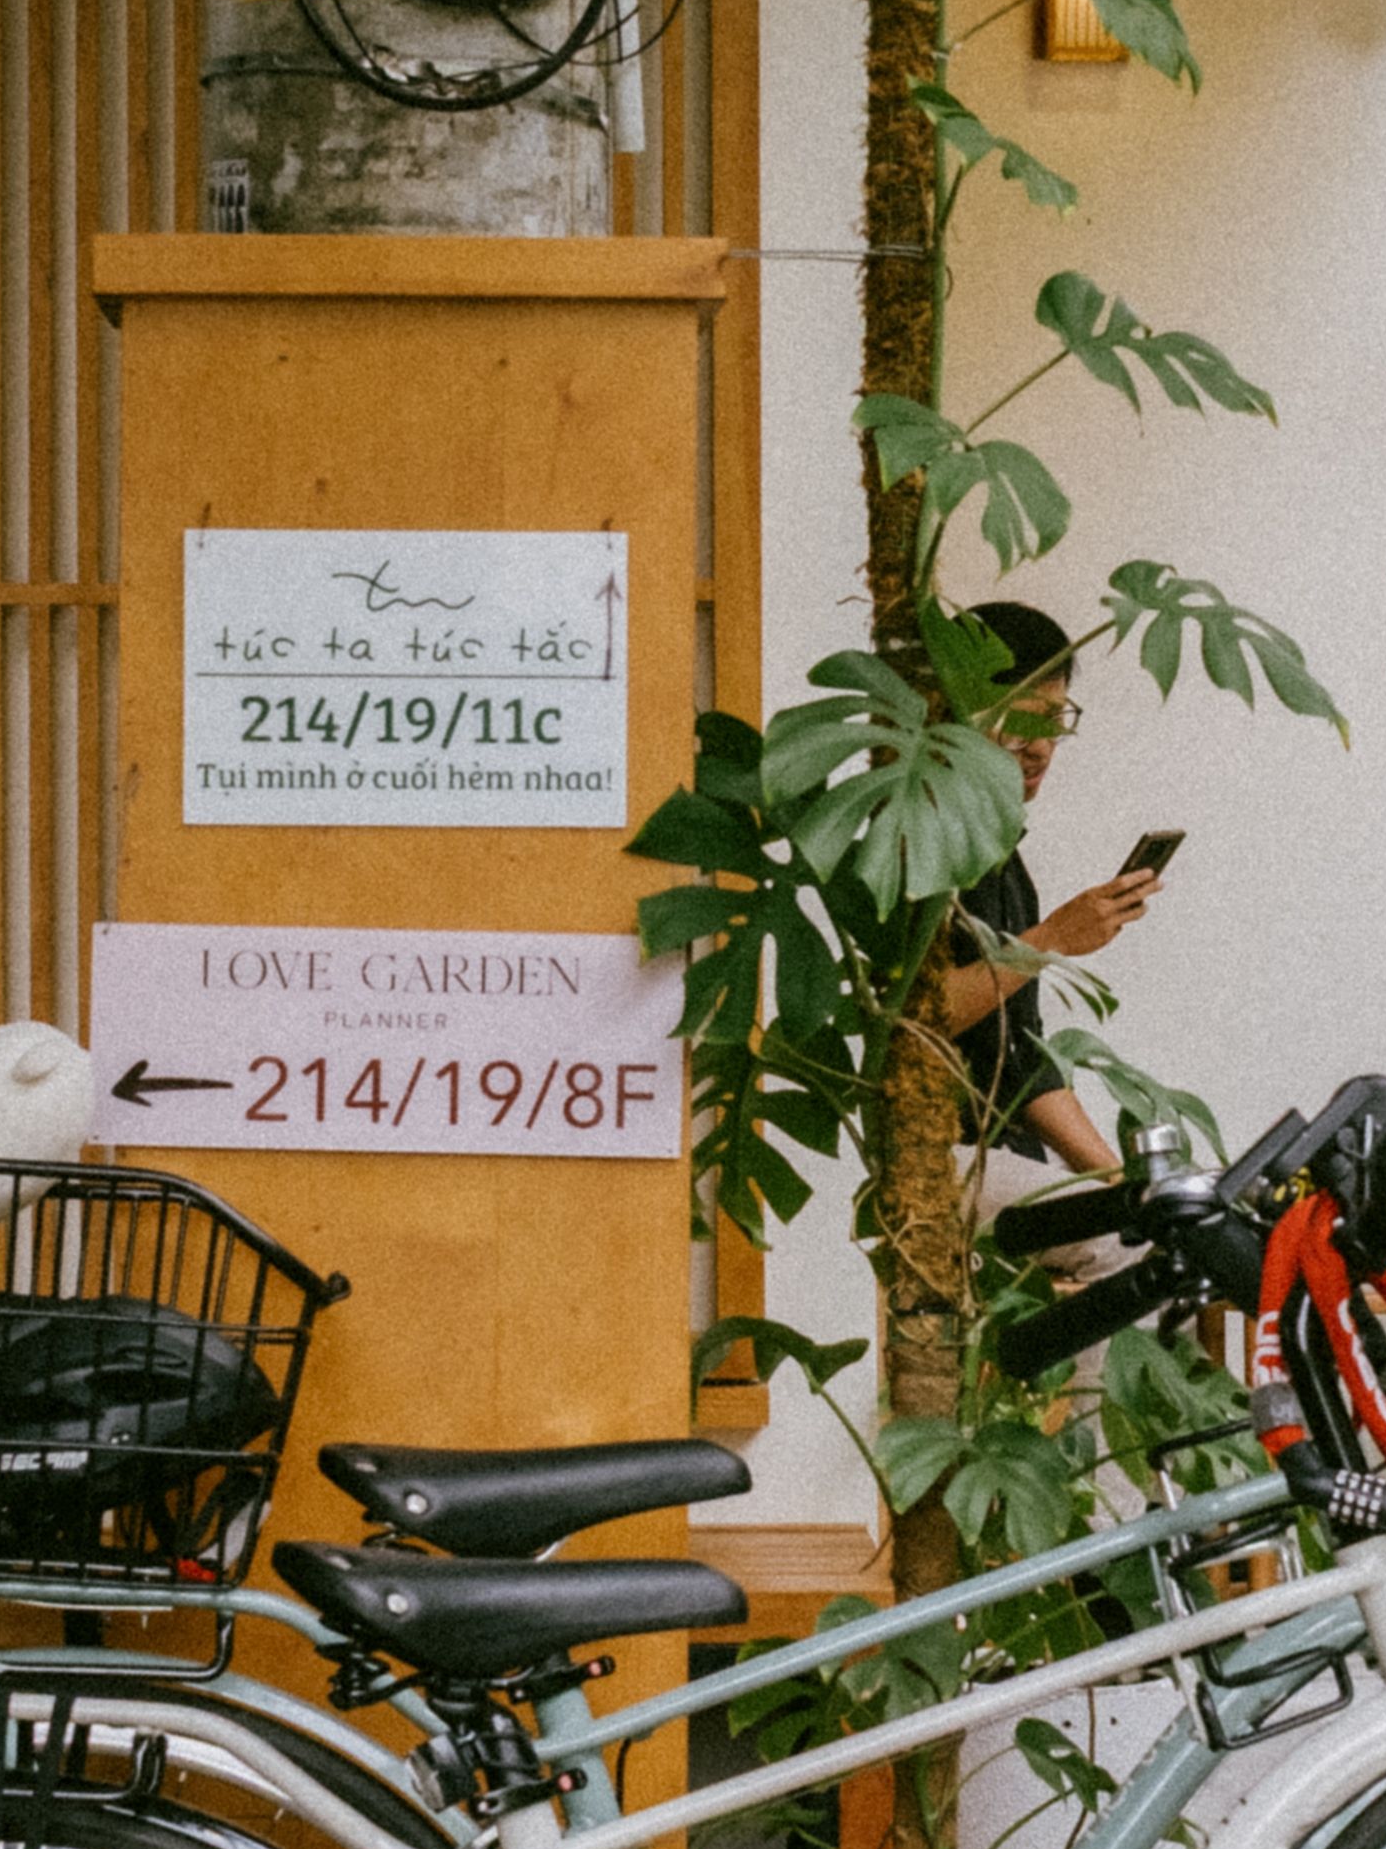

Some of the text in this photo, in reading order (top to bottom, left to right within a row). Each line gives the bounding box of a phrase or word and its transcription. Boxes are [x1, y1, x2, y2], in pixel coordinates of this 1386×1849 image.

[215, 621, 593, 663] túc ta túc tắc
[241, 691, 562, 749] 214/19/11c
[198, 757, 612, 796] Tụi mình ở cuối hẻm nhaa!
[201, 948, 581, 996] LOVE GARDEN
[323, 1010, 448, 1030] PLANNER
[245, 1056, 658, 1130] 214/19/8F
